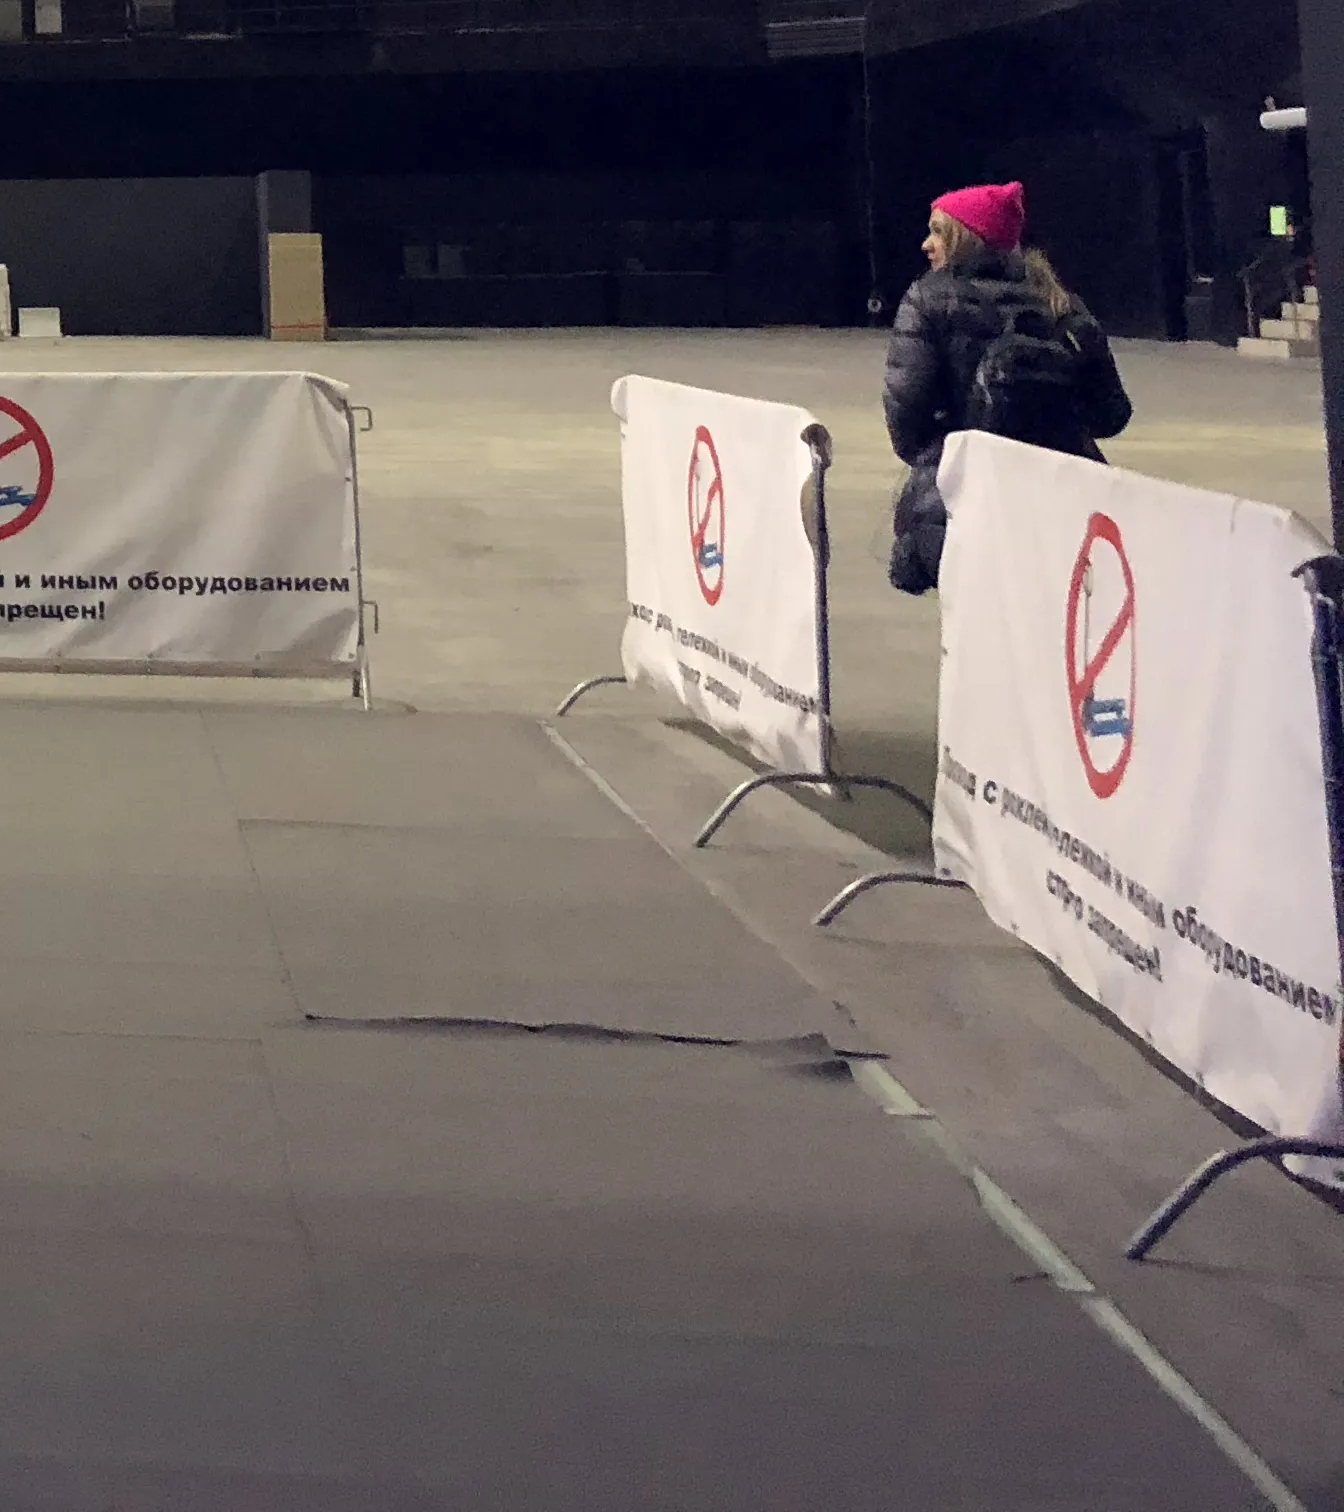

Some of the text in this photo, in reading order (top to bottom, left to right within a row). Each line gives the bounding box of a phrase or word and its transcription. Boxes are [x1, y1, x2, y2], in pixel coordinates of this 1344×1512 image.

[14, 573, 31, 589] и
[41, 572, 119, 590] иным
[127, 570, 351, 595] оборудованием
[983, 780, 997, 804] с
